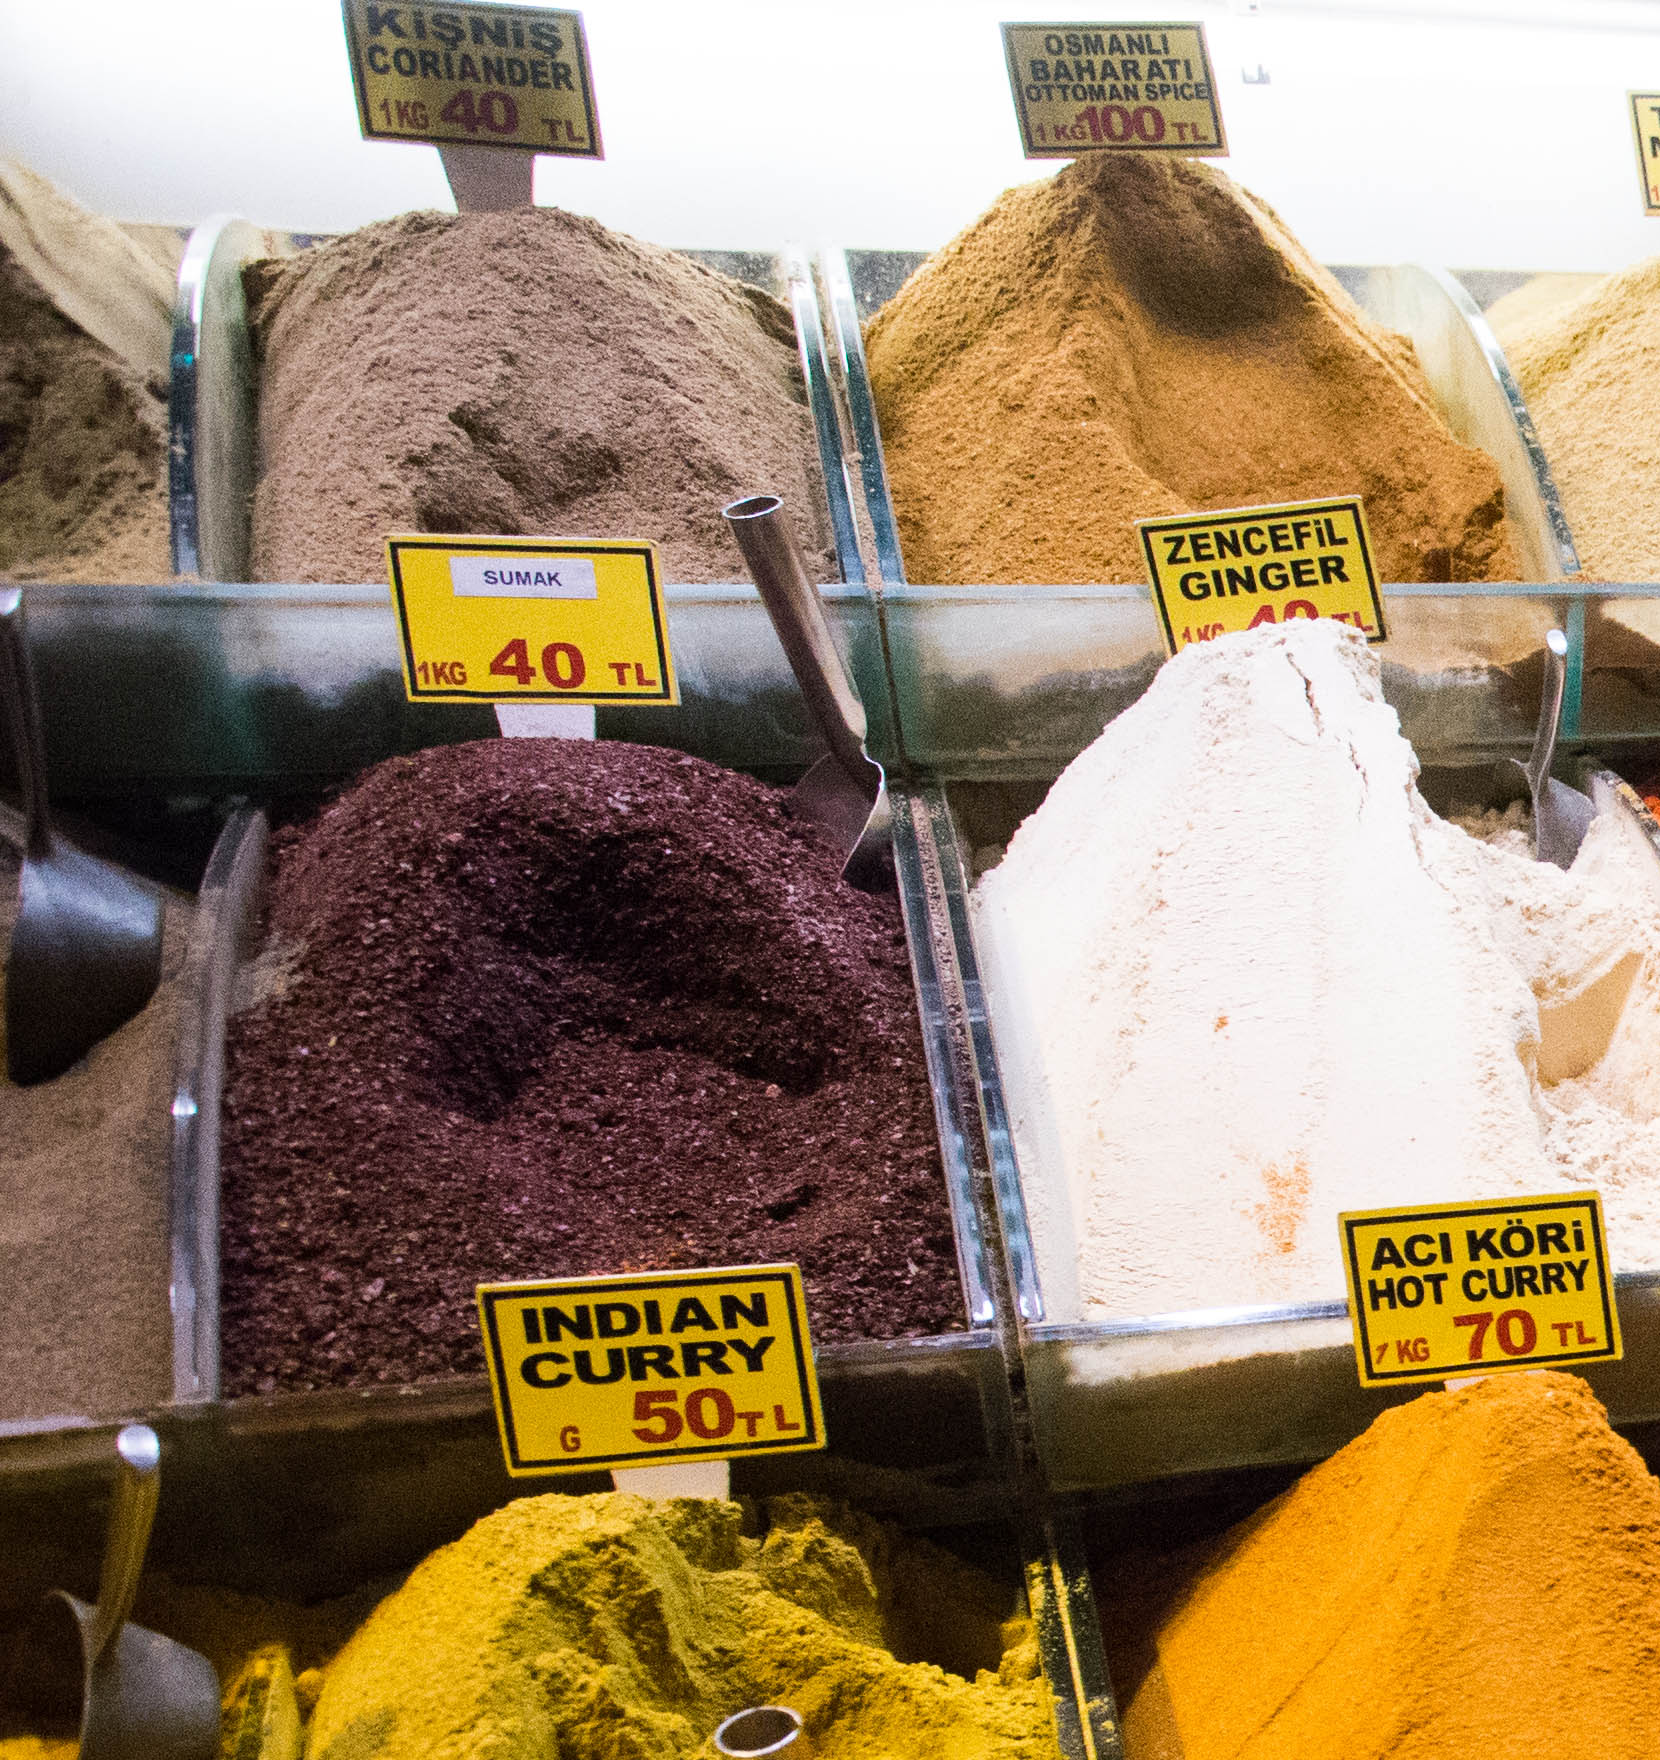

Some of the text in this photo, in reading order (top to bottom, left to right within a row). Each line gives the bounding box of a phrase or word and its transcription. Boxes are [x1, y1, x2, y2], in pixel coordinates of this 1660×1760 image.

[368, 45, 573, 91] CORIANDER
[1045, 33, 1169, 56] OSMANLI
[1025, 80, 1210, 103] OTTOMAN SPICE
[1031, 58, 1193, 84] BAHARATI
[440, 90, 586, 145] 40 TL
[1077, 104, 1209, 143] 100 TL
[484, 568, 563, 588] SUMAK
[1178, 553, 1350, 602] GINGER
[489, 638, 587, 690] 40
[609, 661, 657, 688] TL
[1370, 1230, 1450, 1271] ACI
[1367, 1258, 1590, 1312] HOT CURRY
[520, 1292, 771, 1345] INDIAN
[1452, 1307, 1538, 1361] 70
[1551, 1319, 1597, 1349] TL
[518, 1336, 776, 1391] CURRY
[631, 1386, 737, 1446] 50
